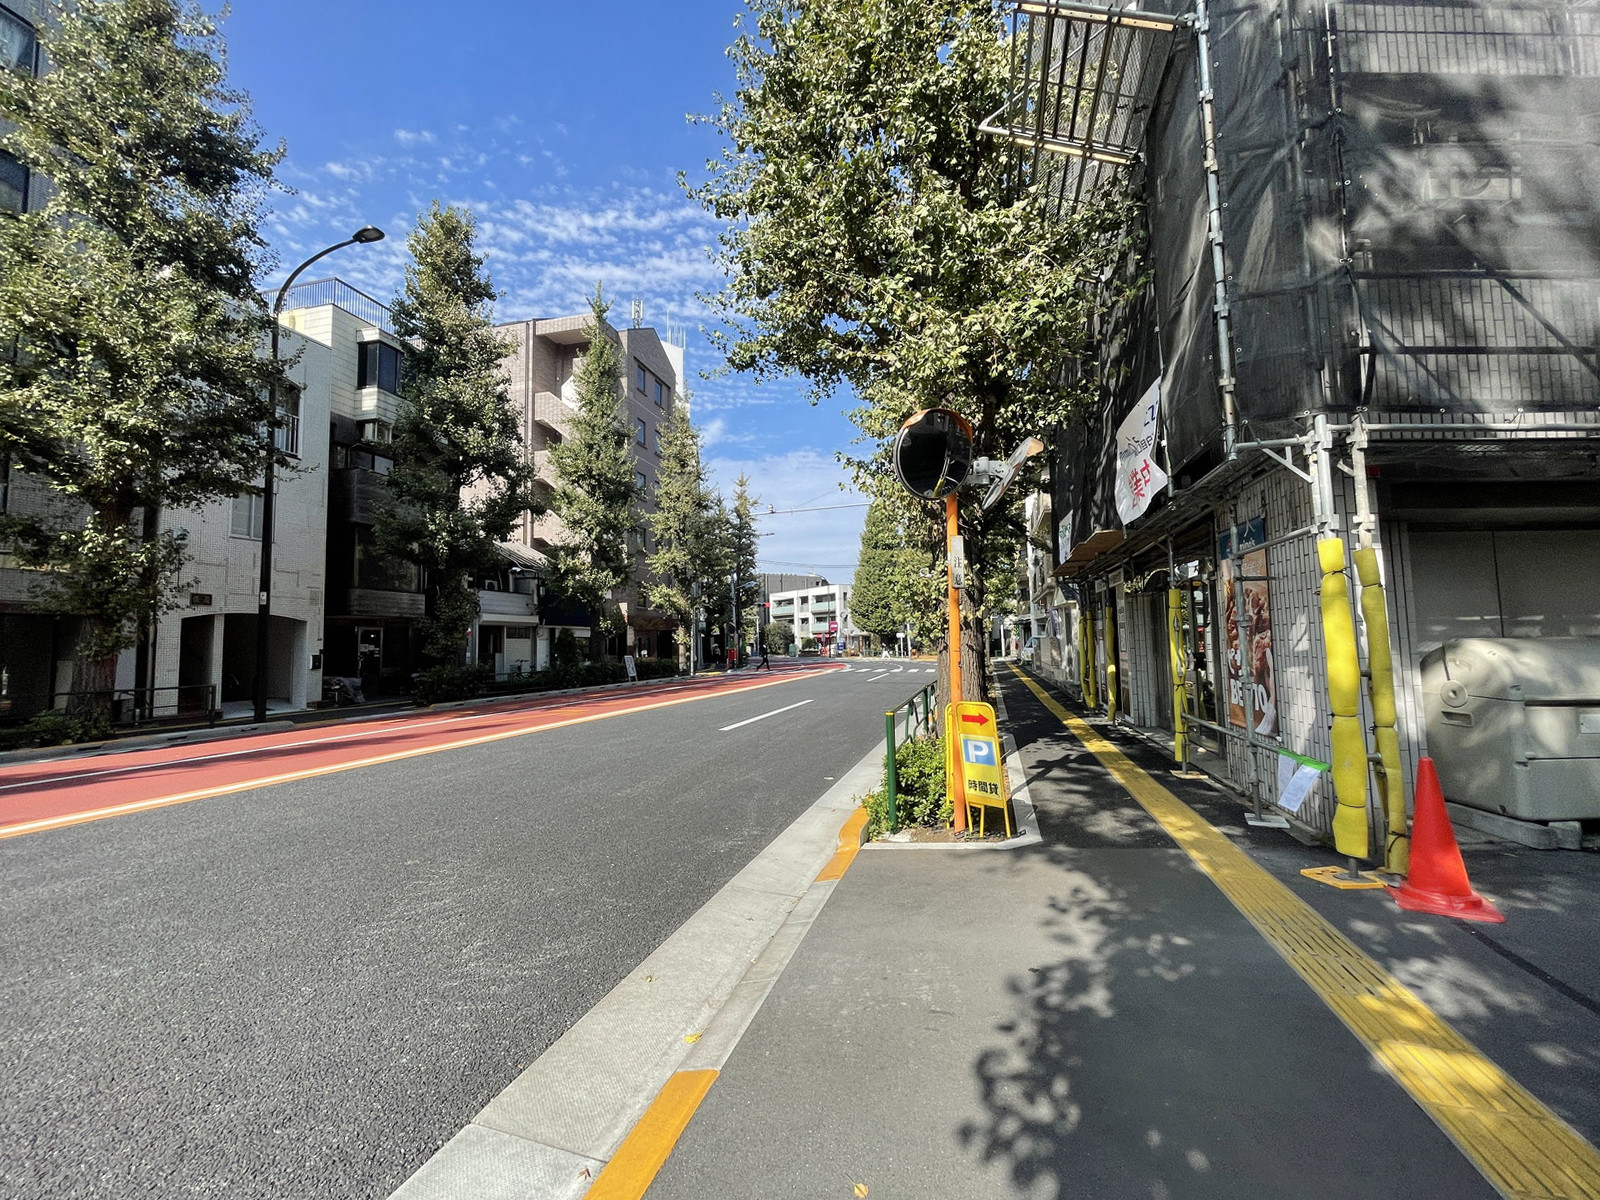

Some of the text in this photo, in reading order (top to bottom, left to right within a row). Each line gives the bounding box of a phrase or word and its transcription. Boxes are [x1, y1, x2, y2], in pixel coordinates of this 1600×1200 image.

[954, 556, 962, 586] 注意
[1230, 680, 1268, 713] BETO
[968, 740, 988, 762] P
[968, 779, 999, 796] 時間貸
